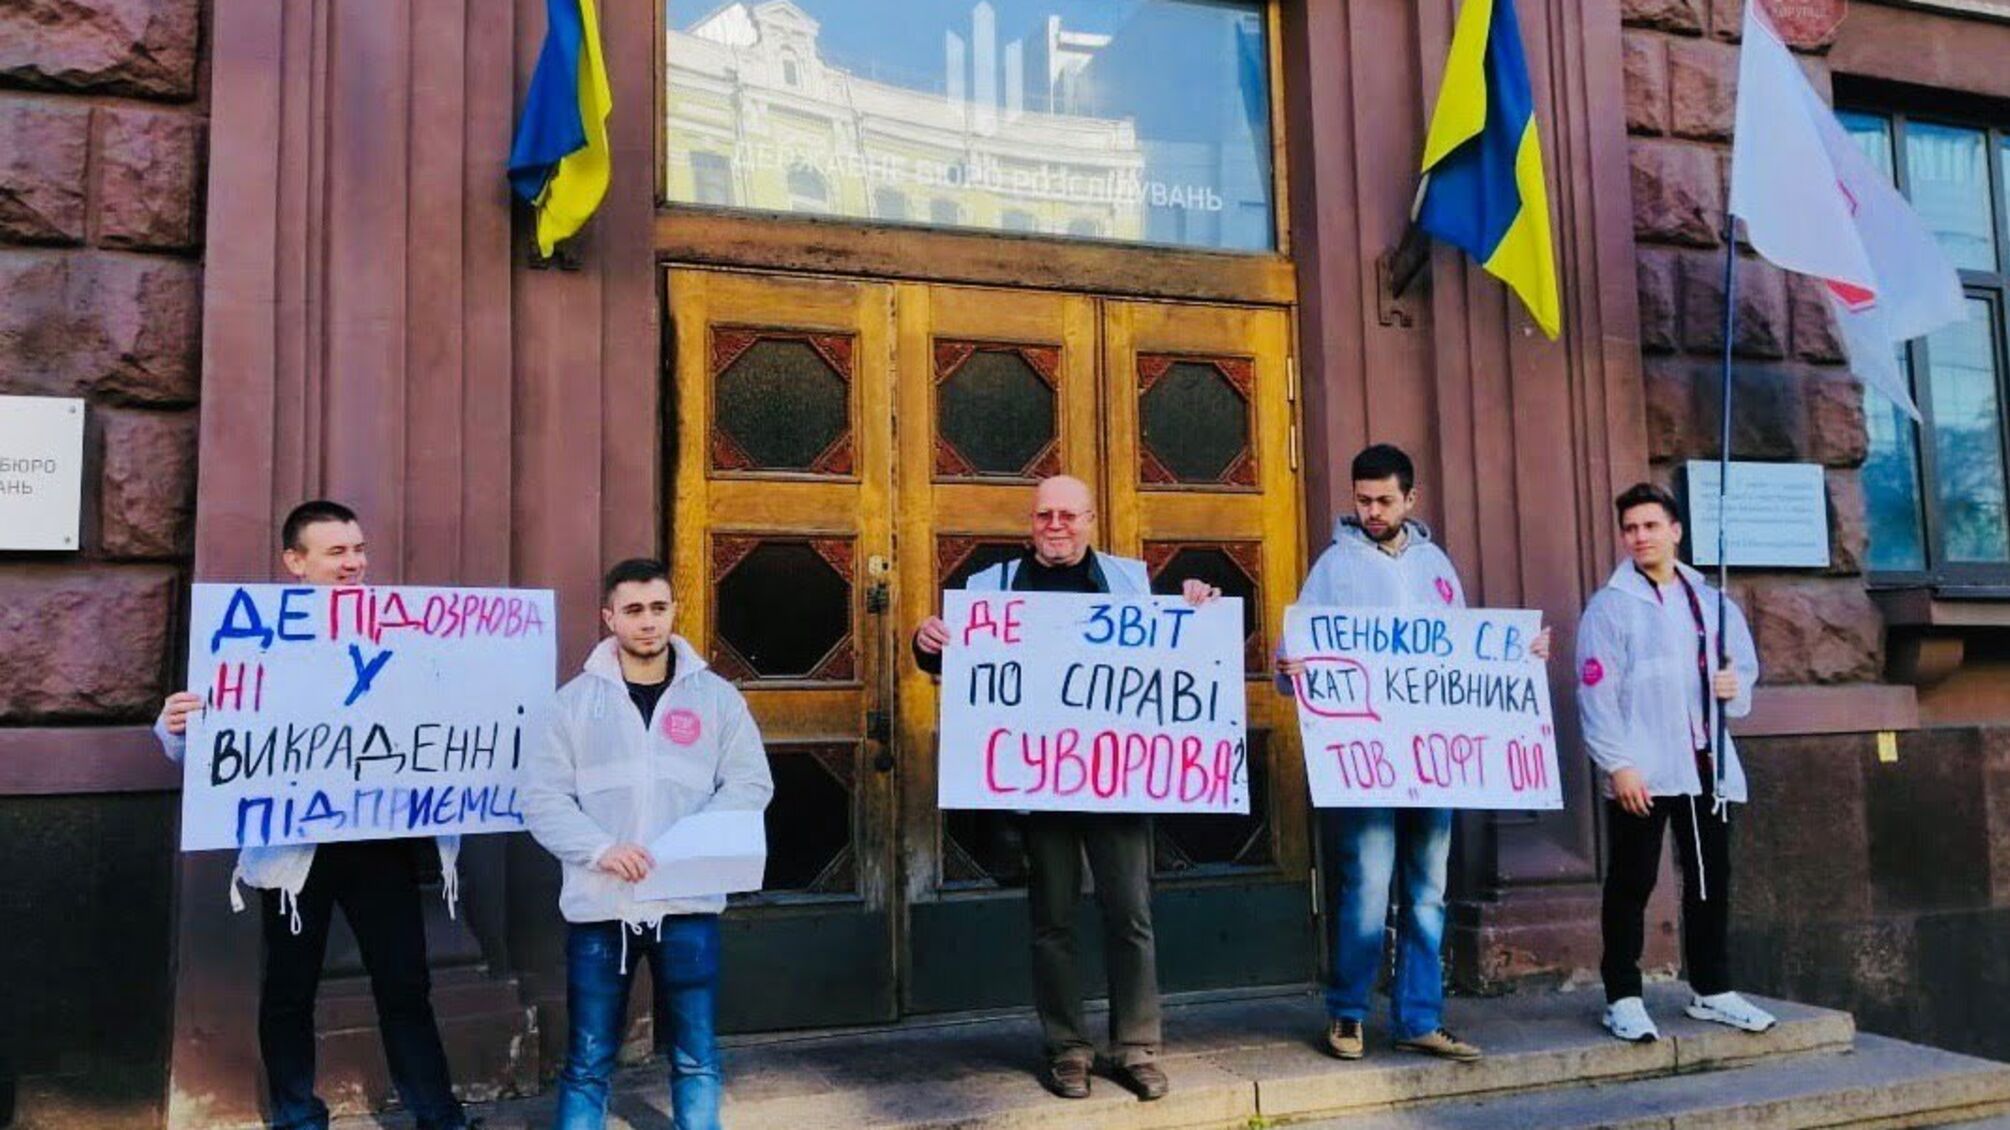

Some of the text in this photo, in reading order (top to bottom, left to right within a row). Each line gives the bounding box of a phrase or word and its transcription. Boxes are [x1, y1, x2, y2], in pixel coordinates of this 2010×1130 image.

[0, 457, 57, 474] БЮРО
[211, 587, 316, 654] ДЕ
[963, 600, 1026, 646] ДЕ
[1310, 615, 1530, 664] ПЕНЬКОВ С.В.
[215, 643, 393, 712] НІ У
[969, 660, 1022, 706] ПО
[1305, 667, 1358, 702] КАТ
[1325, 740, 1396, 789] ТОВ
